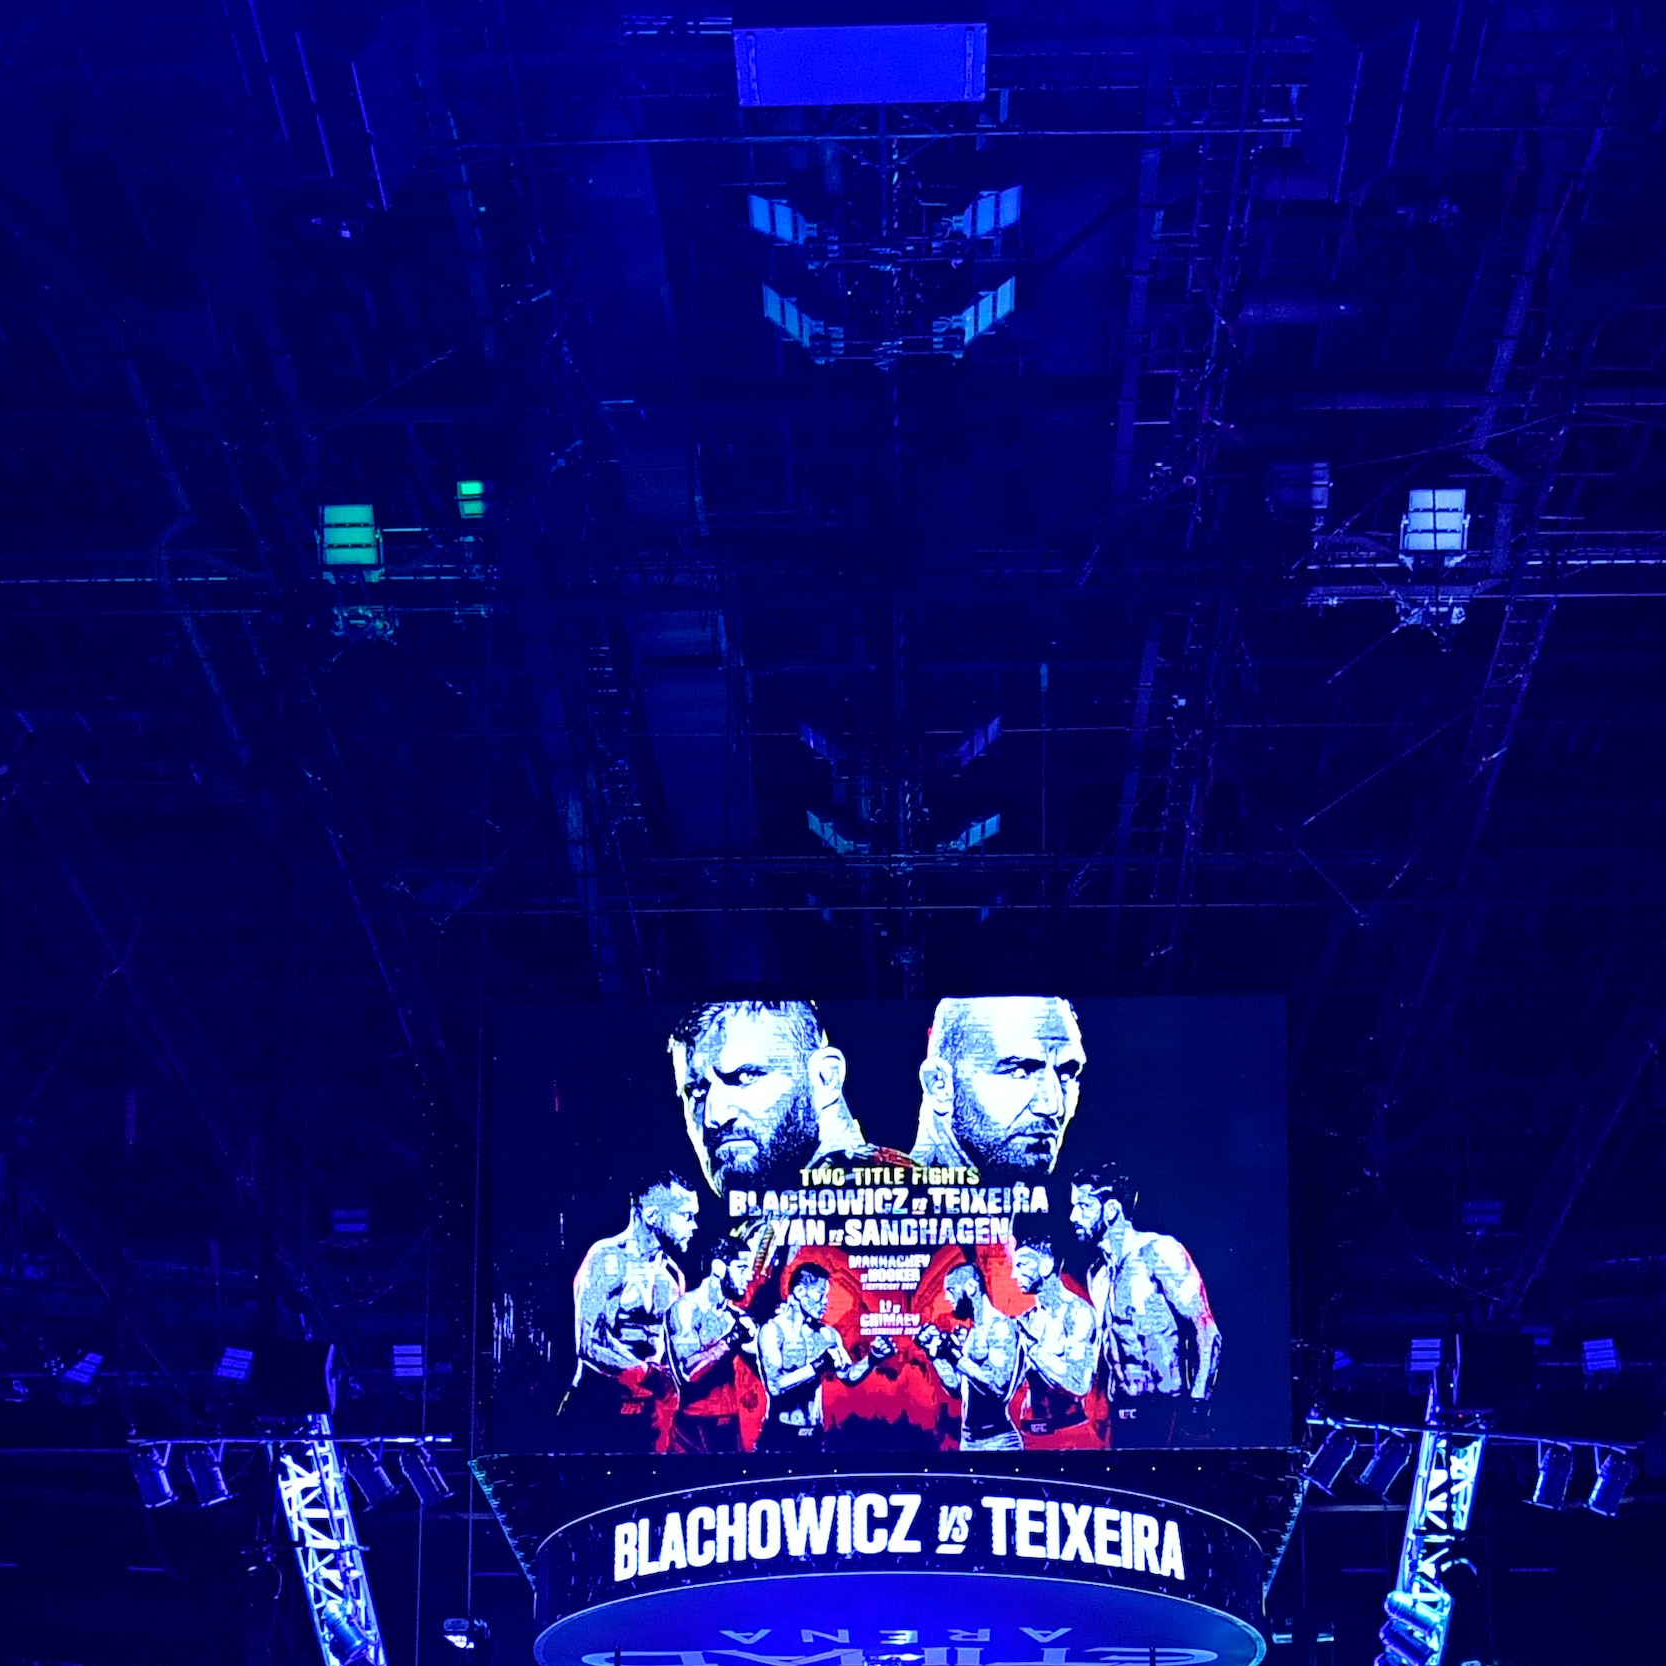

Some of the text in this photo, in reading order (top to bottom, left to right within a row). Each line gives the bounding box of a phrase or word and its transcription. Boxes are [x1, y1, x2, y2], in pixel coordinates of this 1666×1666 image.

[852, 1168, 904, 1186] TITLE
[911, 1167, 980, 1186] FIGHTS
[728, 1188, 909, 1217] BLACHOWICZ
[928, 1185, 1049, 1214] TEIXEIRA
[770, 1219, 825, 1246] YAN
[844, 1217, 1010, 1246] SANDHAGEN
[613, 1494, 921, 1582] BLACHOWICZ
[981, 1495, 1186, 1581] TEIXEIRA
